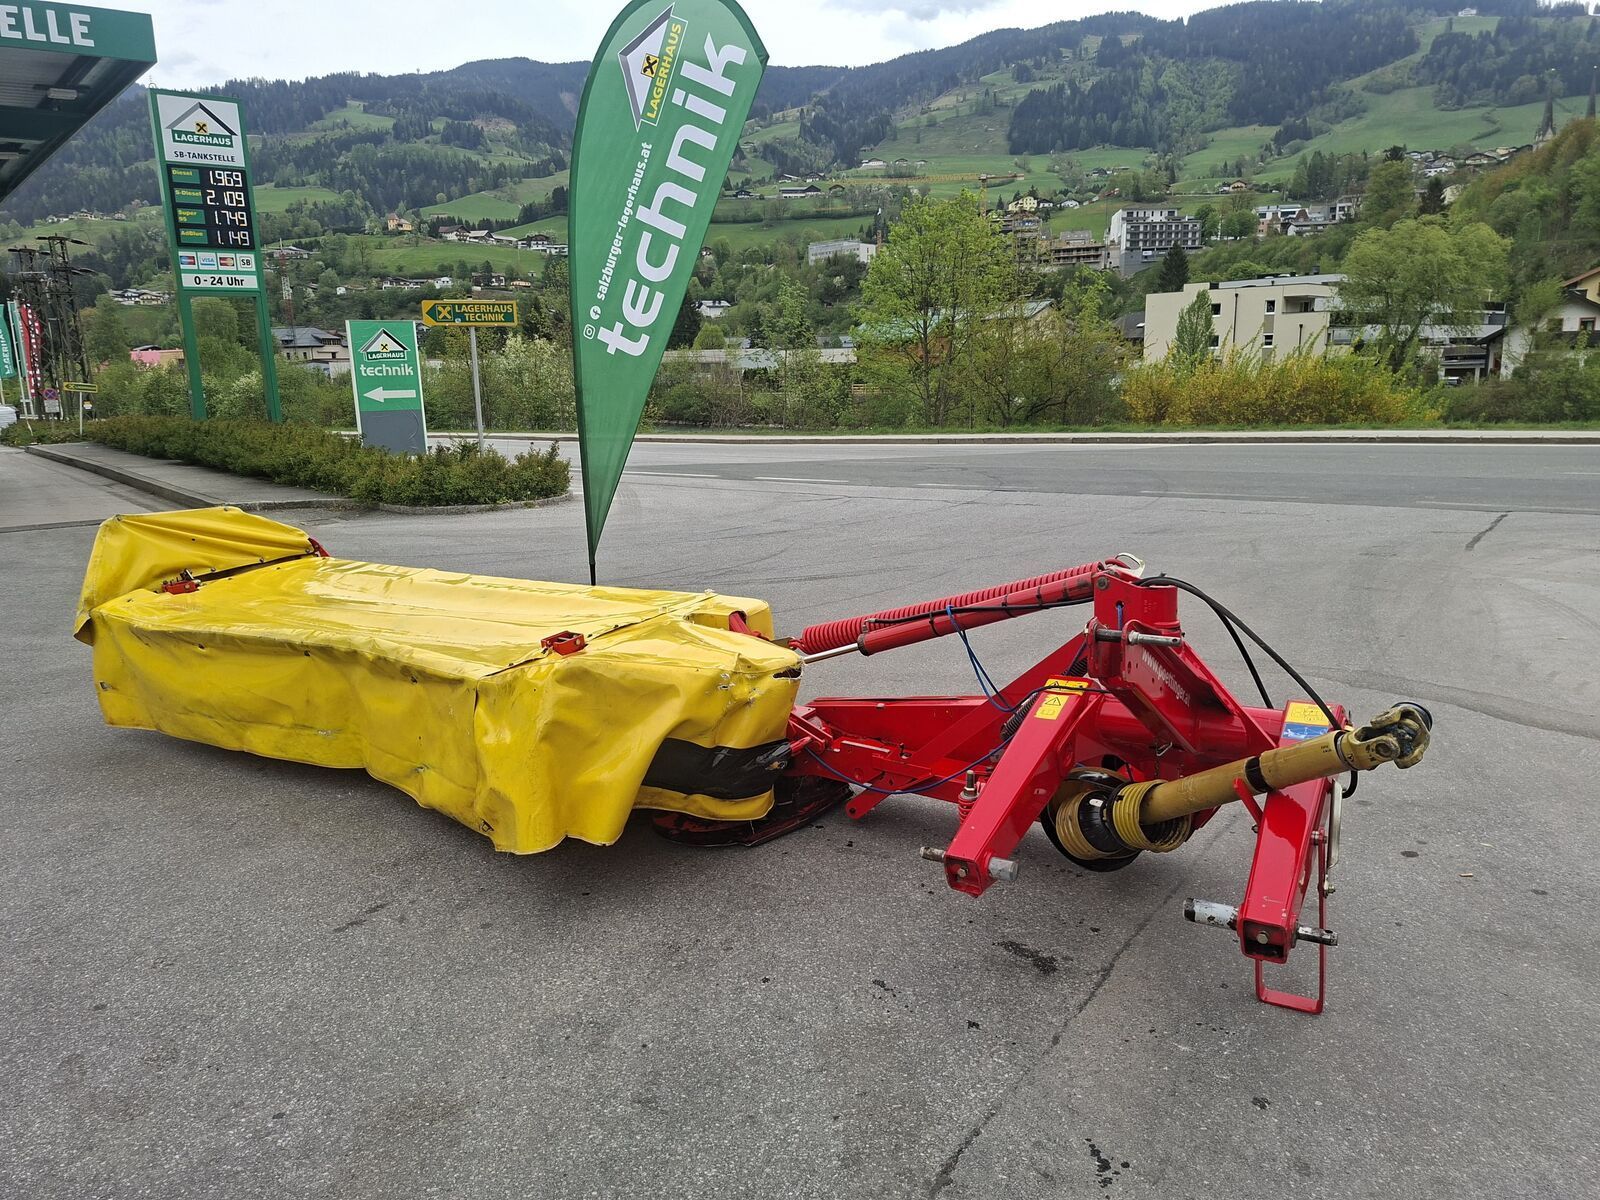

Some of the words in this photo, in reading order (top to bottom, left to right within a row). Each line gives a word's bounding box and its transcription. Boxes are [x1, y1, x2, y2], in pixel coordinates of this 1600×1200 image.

[0, 4, 95, 47] ELLE
[646, 24, 682, 119] LAGERHAUS
[174, 133, 231, 146] LAGERHAUS
[174, 150, 236, 162] SB-TANKSTELLE
[209, 170, 243, 187] 1.969
[206, 189, 246, 207] 2.109
[597, 32, 748, 356] technik
[214, 210, 248, 227] 1.749
[596, 142, 653, 301] salzburger-lagerhaus.at
[217, 230, 250, 246] 1.149
[194, 276, 201, 285] 0
[210, 276, 223, 286] 24
[226, 276, 245, 286] Uhr
[455, 304, 513, 313] LAGERHAUS
[464, 313, 505, 322] TECHNIK
[368, 351, 405, 360] LAGERHAUS
[359, 363, 414, 377] technik
